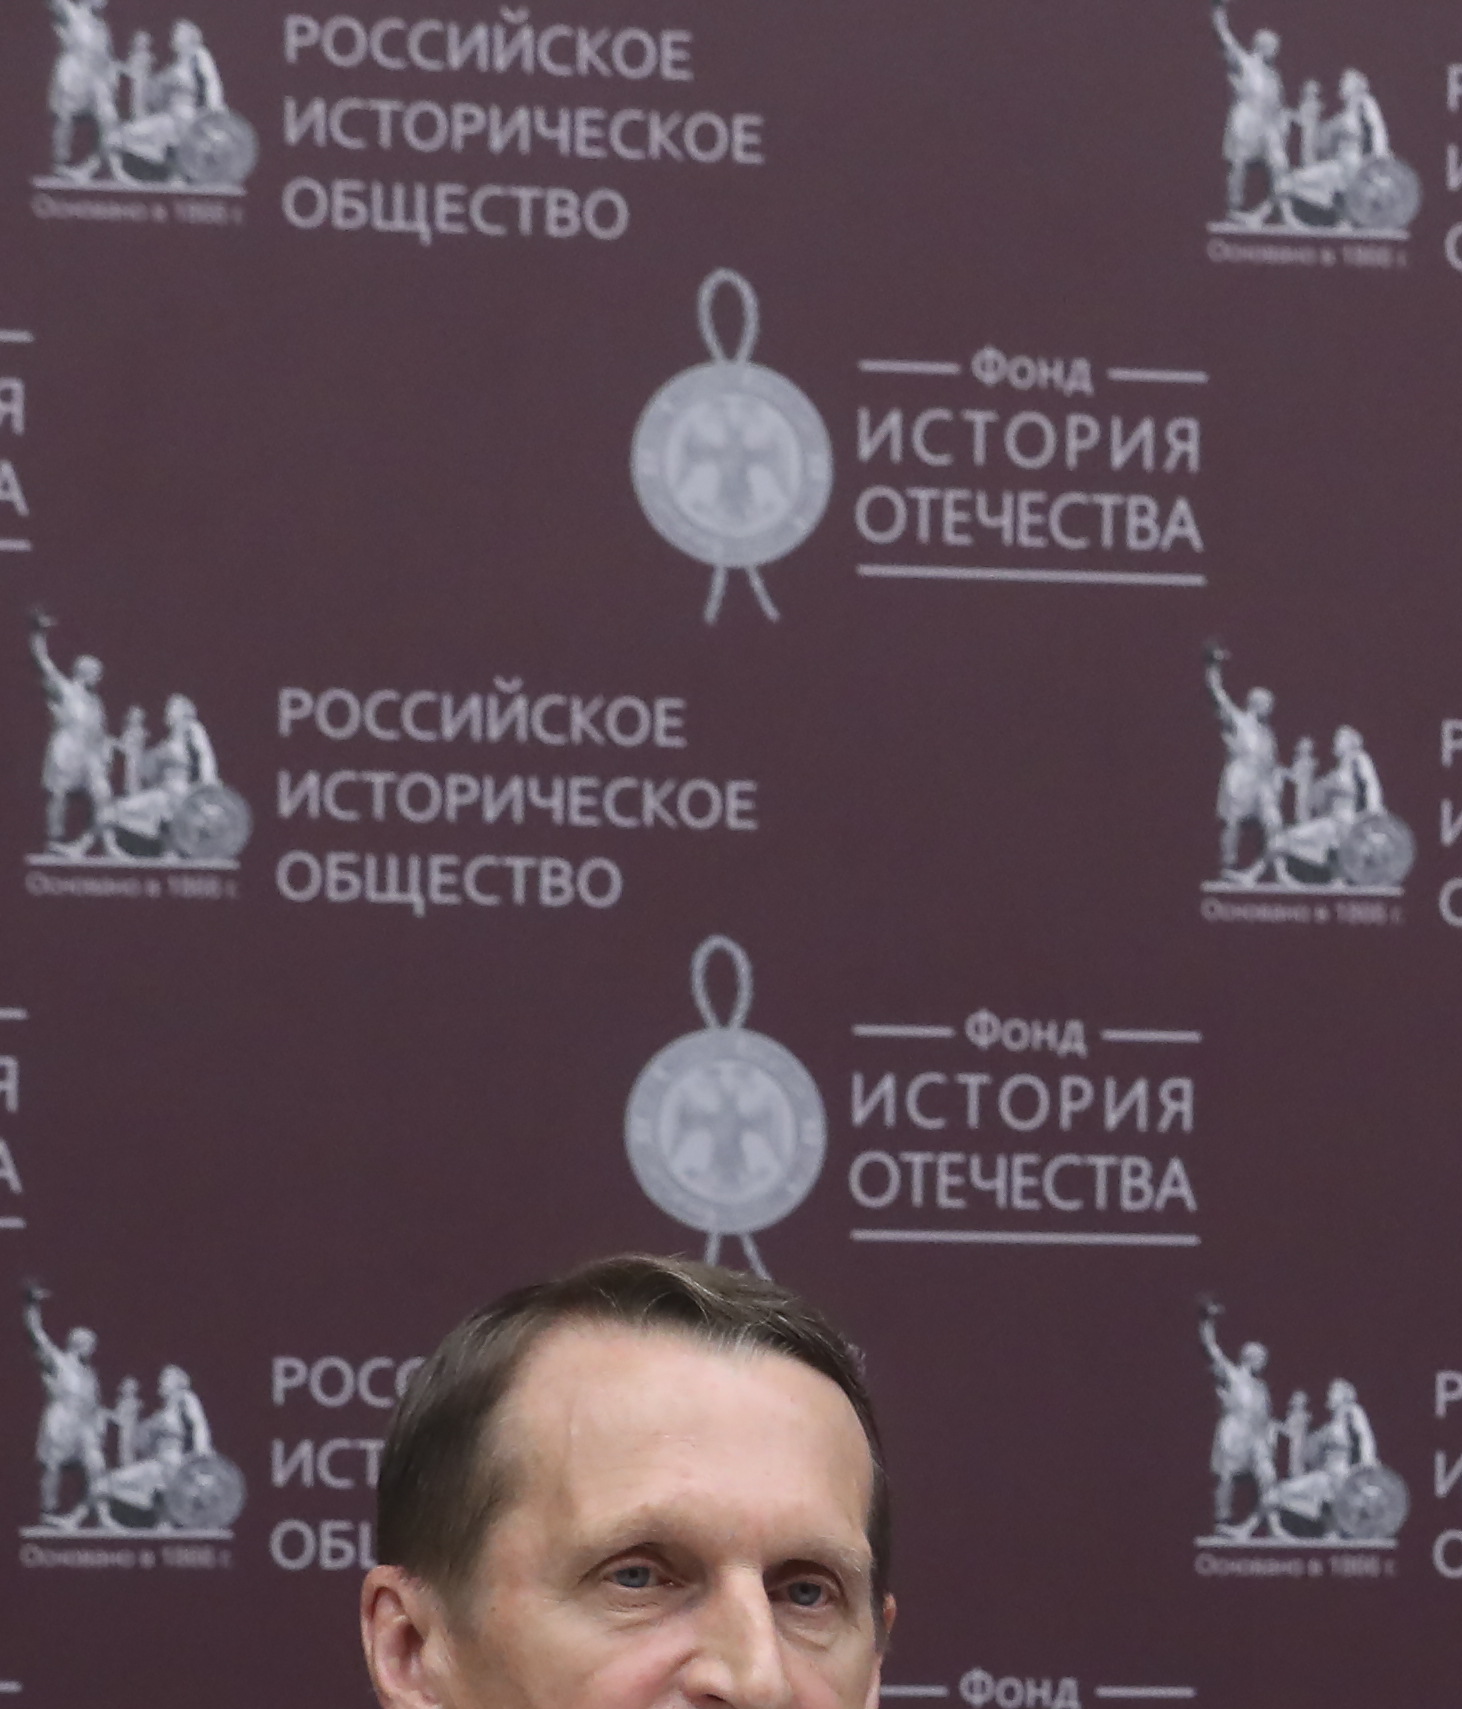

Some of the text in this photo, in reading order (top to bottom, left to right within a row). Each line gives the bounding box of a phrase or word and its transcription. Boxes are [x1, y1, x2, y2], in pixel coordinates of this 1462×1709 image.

[285, 7, 692, 80] РОССИЙСКОЕ
[284, 97, 763, 164] ИСТОРИЧЕСКОЕ
[282, 177, 629, 245] ОБЩЕСТВО
[971, 346, 1094, 395] Фонд
[858, 408, 1199, 472] ИСТОРИЯ
[855, 486, 1203, 551] ОТЕЧЕСТВА
[279, 677, 686, 748] РОССИЙСКОЕ
[278, 770, 757, 830] ИСТОРИЧЕСКОЕ
[276, 851, 622, 916] ОБЩЕСТВО
[965, 1009, 1087, 1057] Фонд
[852, 1072, 1193, 1132] ИСТОРИЯ
[849, 1151, 1196, 1211] ОТЕЧЕСТВА
